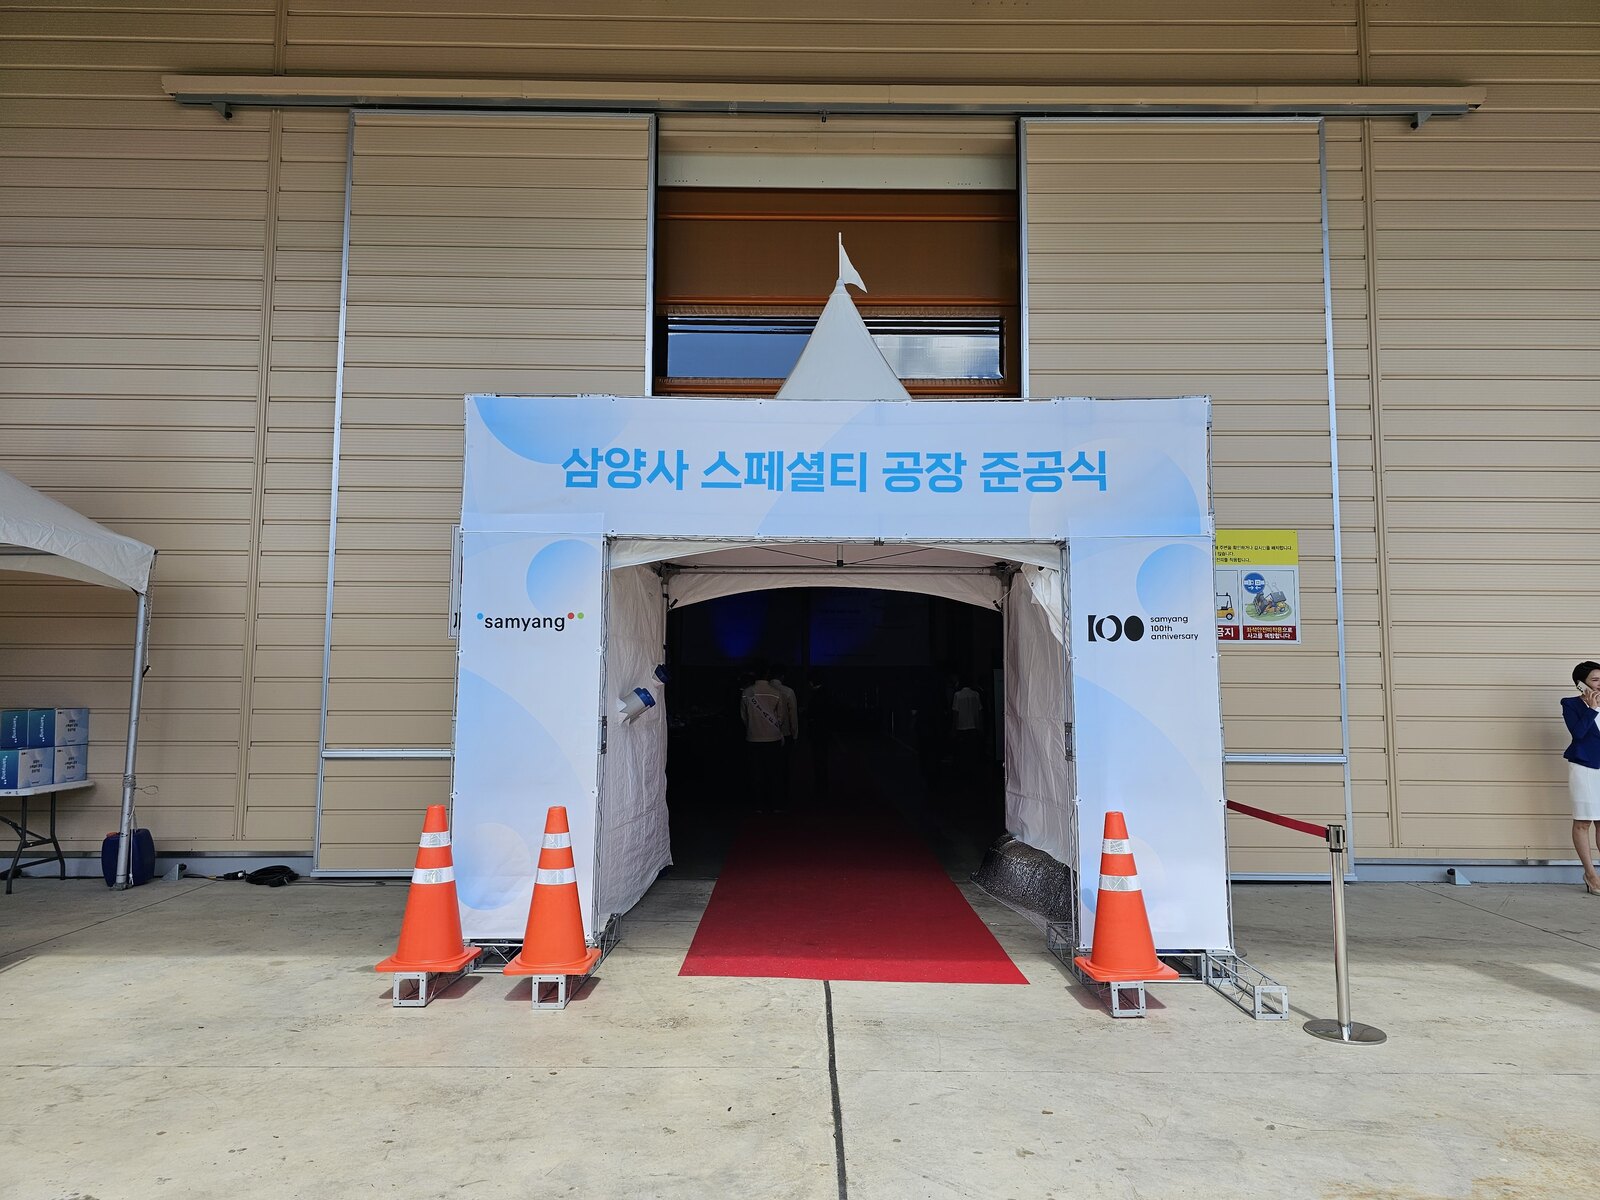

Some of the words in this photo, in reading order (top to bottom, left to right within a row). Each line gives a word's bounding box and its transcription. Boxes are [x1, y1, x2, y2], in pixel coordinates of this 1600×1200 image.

[561, 447, 690, 491] 삼양사
[701, 449, 869, 494] 스페셜티
[882, 450, 967, 494] 공장
[979, 449, 1108, 494] 준공식
[484, 616, 566, 632] samyang
[1150, 616, 1188, 624] samyang
[1151, 632, 1199, 640] anniversary
